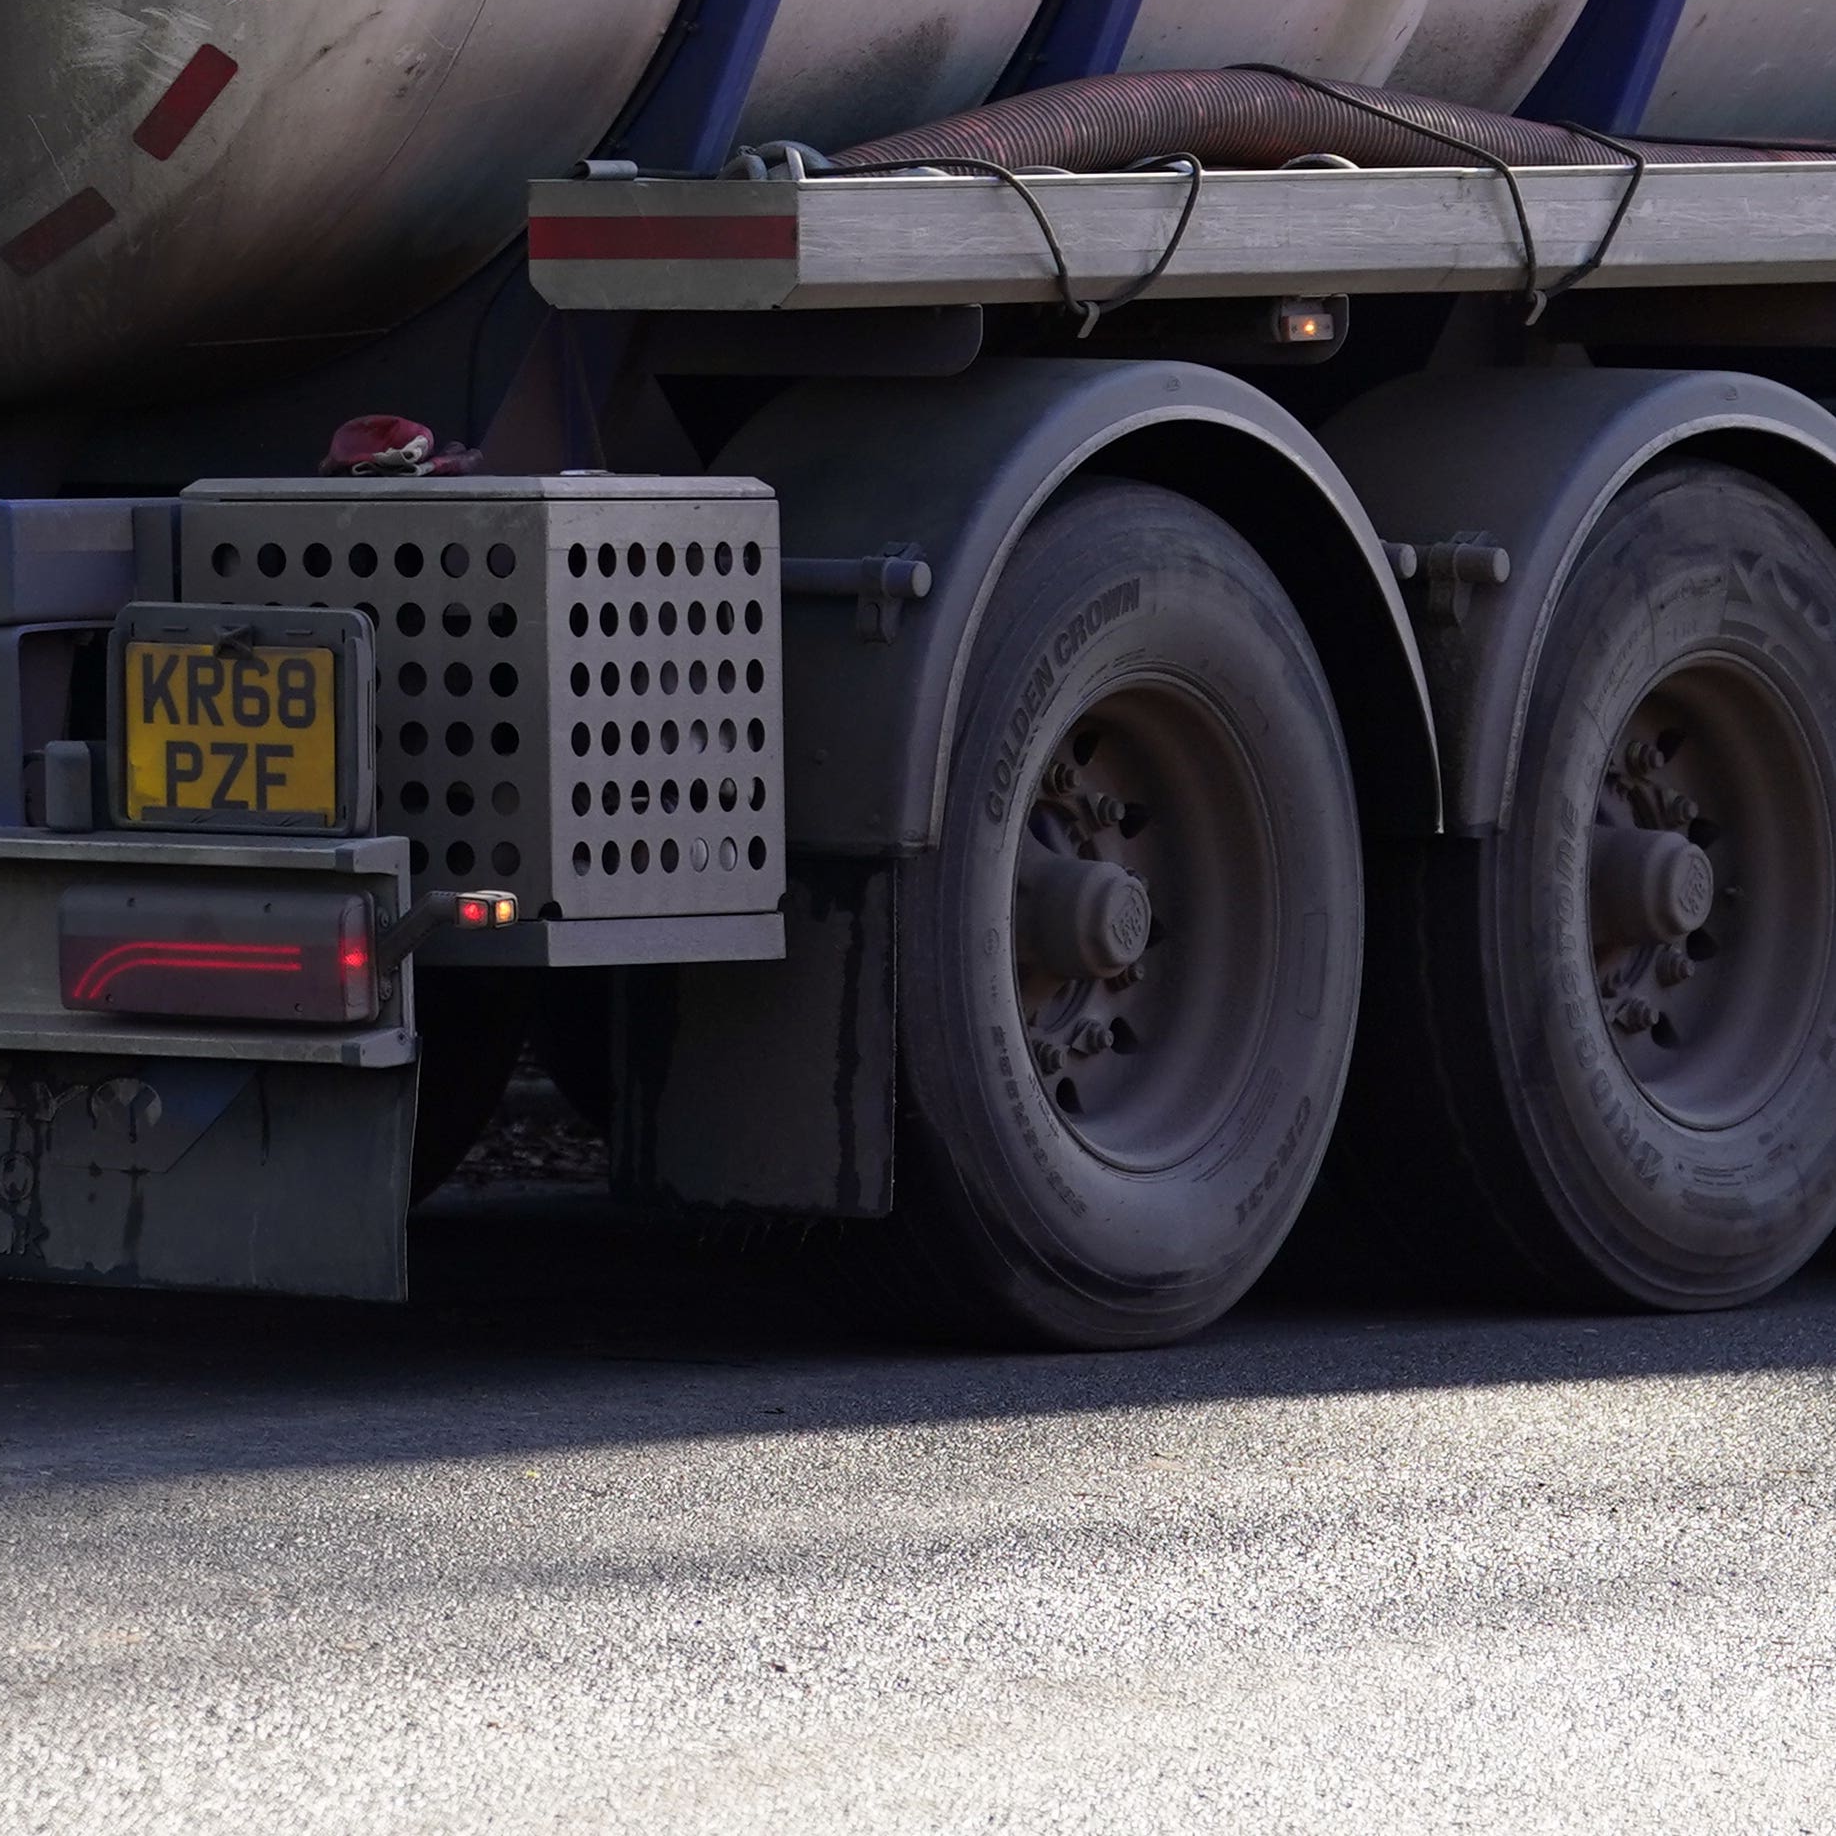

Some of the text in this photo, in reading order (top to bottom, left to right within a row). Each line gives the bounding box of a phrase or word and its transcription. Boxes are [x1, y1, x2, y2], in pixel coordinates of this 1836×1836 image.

[142, 653, 316, 729] KR68
[984, 576, 1141, 825] GOLDEN CROWN
[165, 741, 294, 811] PZF
[1554, 798, 1664, 1192] BRIDGESTONE
